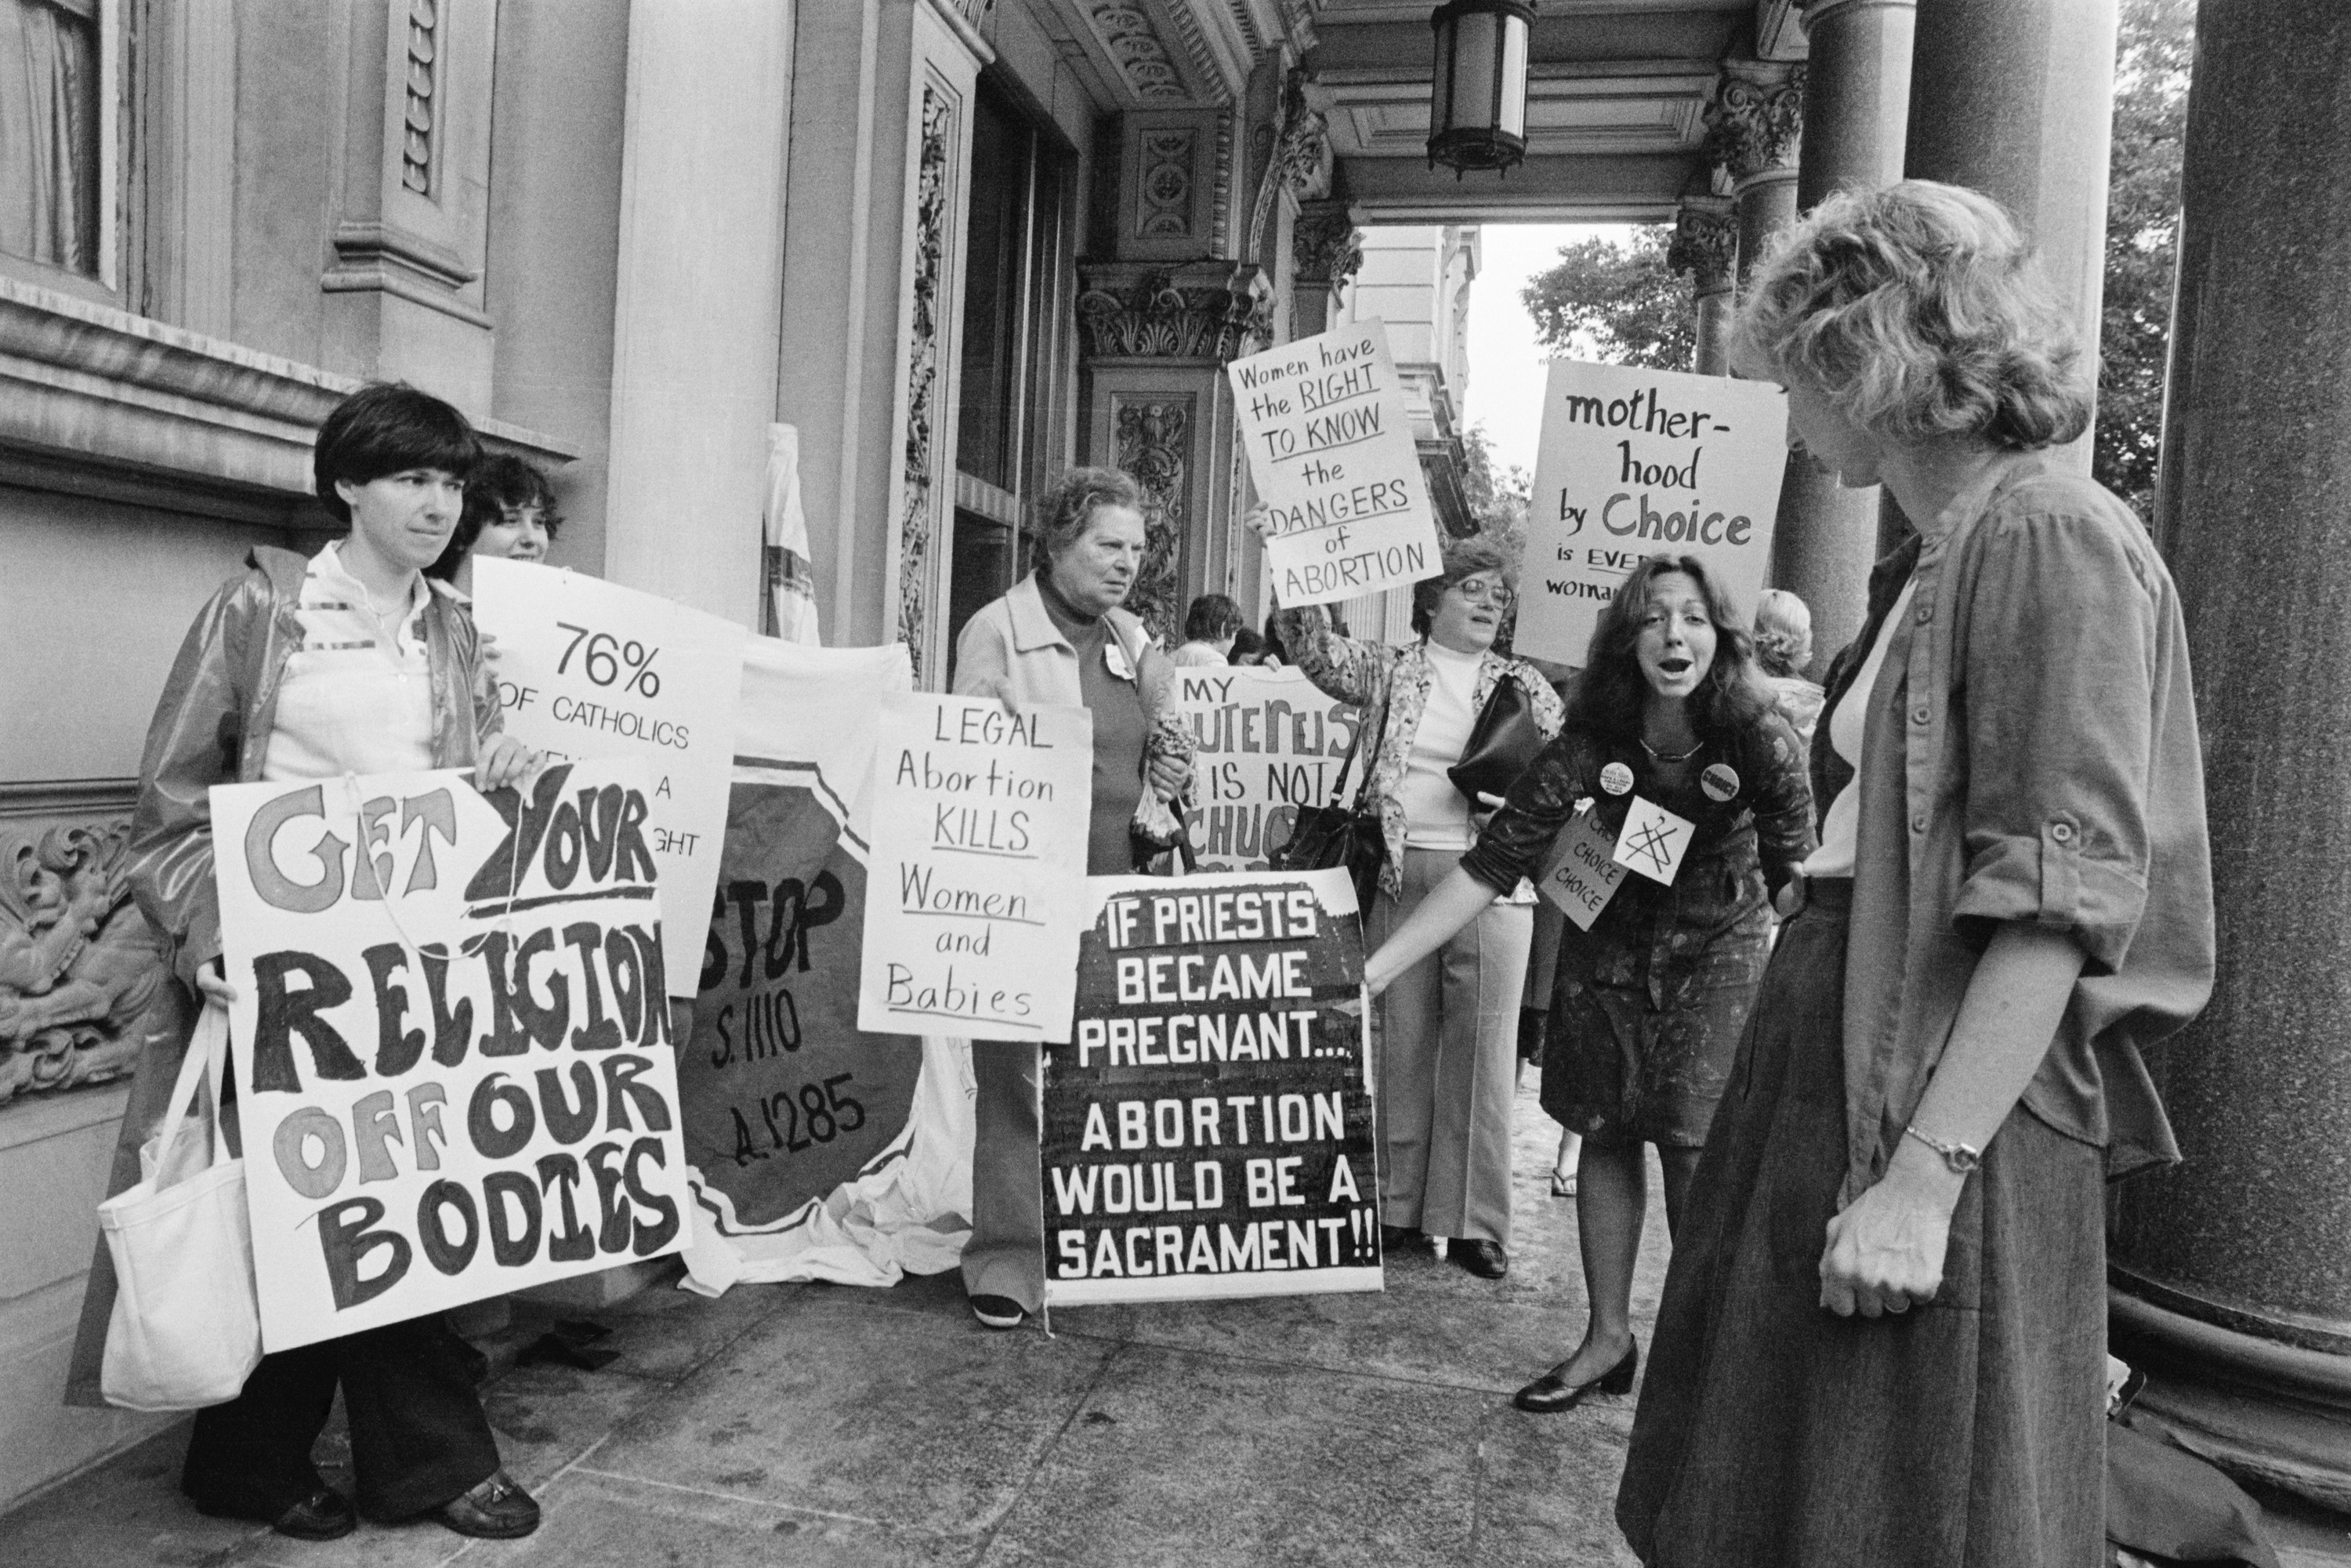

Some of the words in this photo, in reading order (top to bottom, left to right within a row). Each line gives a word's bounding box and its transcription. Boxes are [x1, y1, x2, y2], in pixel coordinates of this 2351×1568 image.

[1238, 358, 1308, 389] Women
[1319, 339, 1375, 368] have
[1250, 393, 1291, 422] the
[1299, 363, 1374, 408] RIGHT
[1566, 387, 1730, 439] mother-
[1262, 428, 1295, 457] TO
[1306, 402, 1379, 448] KNOW
[1302, 459, 1344, 487] the
[1617, 440, 1703, 489] hood
[1270, 479, 1408, 533] DANGERS
[1559, 487, 1588, 536] by
[1602, 492, 1751, 545] Choice
[1325, 525, 1350, 553] of
[1557, 542, 1574, 561] is
[1286, 542, 1425, 598] ABORTION
[1546, 579, 1619, 601] woma
[556, 621, 661, 698] 76%
[499, 682, 538, 711] OF
[552, 697, 690, 750] CATHOLICS
[1183, 676, 1236, 703] MY
[934, 704, 1053, 749] LEGAL
[656, 775, 671, 799] A
[896, 749, 1053, 802] Abortion
[1212, 761, 1245, 800] IS
[1267, 762, 1331, 807] NOT
[245, 784, 457, 914] GET
[458, 763, 658, 901] YOUR
[654, 827, 701, 856] GHT
[933, 802, 1030, 851] KILLS
[900, 861, 1027, 918] Women
[1556, 867, 1603, 912] CHOICE
[1574, 842, 1619, 885] CHOICE
[935, 923, 991, 957] and
[1107, 898, 1140, 949] IF
[1154, 889, 1317, 945] PRIESTS
[886, 963, 1031, 1016] Babies
[1117, 950, 1312, 1005] BECAME
[252, 920, 673, 1094] RELIGION
[273, 1081, 448, 1199] OFF
[468, 1053, 672, 1159] OUR
[1080, 1091, 1345, 1151] ABORTION
[1051, 1160, 1223, 1215] WOULD
[1245, 1156, 1306, 1208] BE
[1328, 1153, 1361, 1203] A
[317, 1136, 680, 1312] BODIES
[1057, 1208, 1374, 1279] SACRAMENT!!
